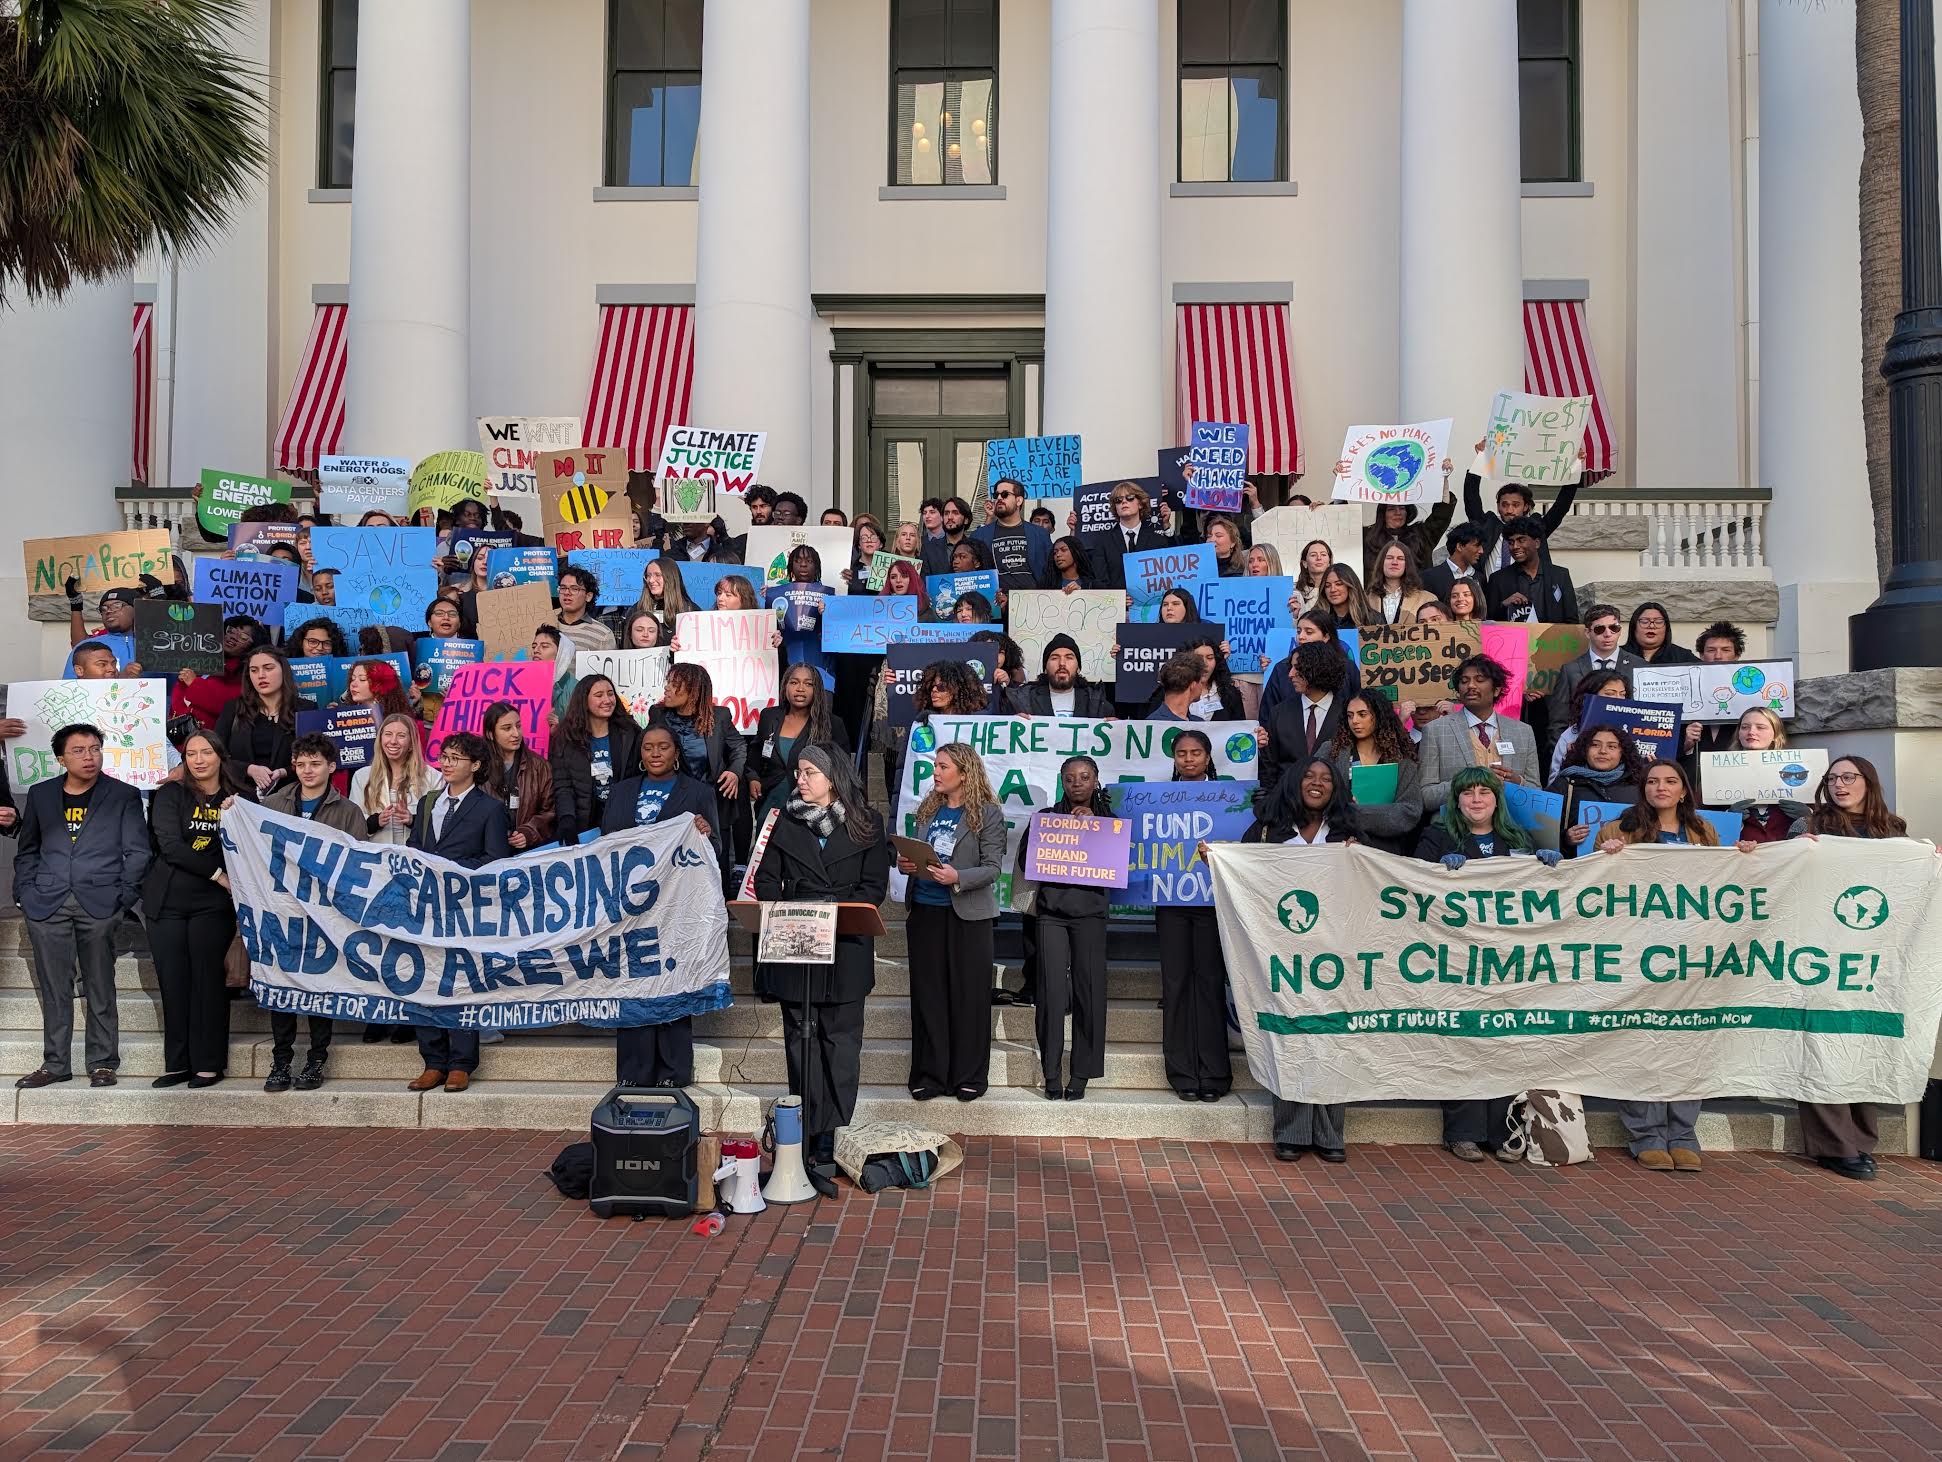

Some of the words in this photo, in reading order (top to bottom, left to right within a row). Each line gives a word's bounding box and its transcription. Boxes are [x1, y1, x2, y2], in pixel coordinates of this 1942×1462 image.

[485, 423, 520, 441] WE
[523, 423, 573, 445] WANT
[672, 430, 758, 452] CLIMATE
[1198, 426, 1236, 443] WE
[988, 440, 1018, 457] SEA
[1028, 436, 1079, 453] LEVELS
[1380, 428, 1397, 440] NO
[1402, 428, 1432, 445] PLACE
[1425, 446, 1436, 471] LIKE
[1536, 433, 1574, 455] In
[340, 459, 379, 467] WATER
[666, 448, 753, 470] JUSTICE
[988, 457, 1017, 471] ARE
[1191, 447, 1245, 466] NEED
[323, 465, 368, 474] ENERGY
[372, 466, 406, 474] HOGS:
[553, 457, 575, 478] DO
[584, 453, 606, 474] IT
[1042, 467, 1071, 481] ARE
[1504, 452, 1572, 481] Earth
[418, 472, 481, 497] CHANGING
[1188, 467, 1246, 490] CHANGE
[219, 479, 272, 497] CLEAN
[327, 485, 355, 494] DATA
[358, 486, 405, 496] CENTERS
[1358, 487, 1415, 502] HOME
[212, 489, 277, 506] ENERGY
[346, 494, 368, 503] PAY
[1080, 493, 1099, 502] ACT
[1081, 514, 1091, 522] &
[1093, 511, 1116, 521] CLE
[1081, 522, 1118, 533] ENERGY
[326, 532, 423, 570] SAVE
[555, 531, 585, 555] FOR
[581, 550, 640, 560] SOLUTION
[1165, 553, 1200, 573] OUR
[34, 554, 84, 592] NOT
[84, 553, 99, 577] A
[209, 568, 282, 588] CLIMATE
[871, 567, 887, 578] NO
[211, 585, 278, 602] ACTION
[1224, 587, 1270, 617] need
[223, 603, 268, 617] NOW
[1012, 592, 1060, 631] We
[676, 612, 776, 652] CLIMATE
[911, 625, 941, 637] ONLY
[1228, 618, 1275, 636] HUMAN
[1123, 647, 1176, 659] FIGHT
[1228, 637, 1267, 654] CHAN
[1360, 643, 1432, 665] Green
[1441, 636, 1471, 660] do
[1123, 661, 1154, 672] OUR
[446, 667, 526, 698] FUCK
[337, 708, 372, 718] PROTECT
[1606, 704, 1675, 717] ENVIRONMENTAL
[1641, 715, 1675, 723] JUSTICE
[336, 717, 375, 728] FLORIDA
[343, 727, 376, 736] CLIMATE
[344, 733, 377, 741] CHANGE
[943, 720, 1050, 755] THERE
[1056, 722, 1112, 756] IS
[1632, 727, 1672, 737] FLORIDA
[103, 742, 163, 769] THE
[340, 748, 365, 757] PODER
[1712, 752, 1748, 766] MAKE
[1761, 751, 1801, 762] EARTH
[1124, 788, 1157, 811] for
[1160, 790, 1191, 804] our
[1192, 787, 1239, 803] sake
[1511, 788, 1557, 813] OFF
[1715, 789, 1748, 801] COOL
[1758, 788, 1794, 799] AGAIN
[1039, 817, 1101, 831] FLORIDA'S
[1142, 811, 1213, 840] FUND
[1039, 832, 1079, 845] YOUTH
[1036, 848, 1088, 862] DEMAND
[259, 819, 383, 924] THE
[388, 853, 423, 877] SEAS
[415, 867, 498, 938] ARE
[499, 845, 660, 937] RISING
[1035, 863, 1068, 876] THEIR
[1070, 867, 1116, 880] FUTURE
[787, 908, 818, 918] ADVOCACY
[818, 910, 831, 920] DAY
[1380, 886, 1561, 928] SYSTEM
[1576, 883, 1770, 924] CHANGE
[236, 902, 339, 974] AND
[342, 929, 426, 997] SO
[437, 947, 564, 998] ARE
[1269, 952, 1384, 994] NOT
[1398, 942, 1623, 986] CLIMATE
[1639, 939, 1880, 993] CHANGE!
[267, 988, 334, 1015] FUTURE
[335, 993, 369, 1019] FOR
[371, 999, 410, 1021] ALL
[1347, 1013, 1390, 1031] JUST
[1479, 1013, 1516, 1030] FOR
[1523, 1011, 1555, 1025] ALL
[616, 1160, 660, 1171] ION
